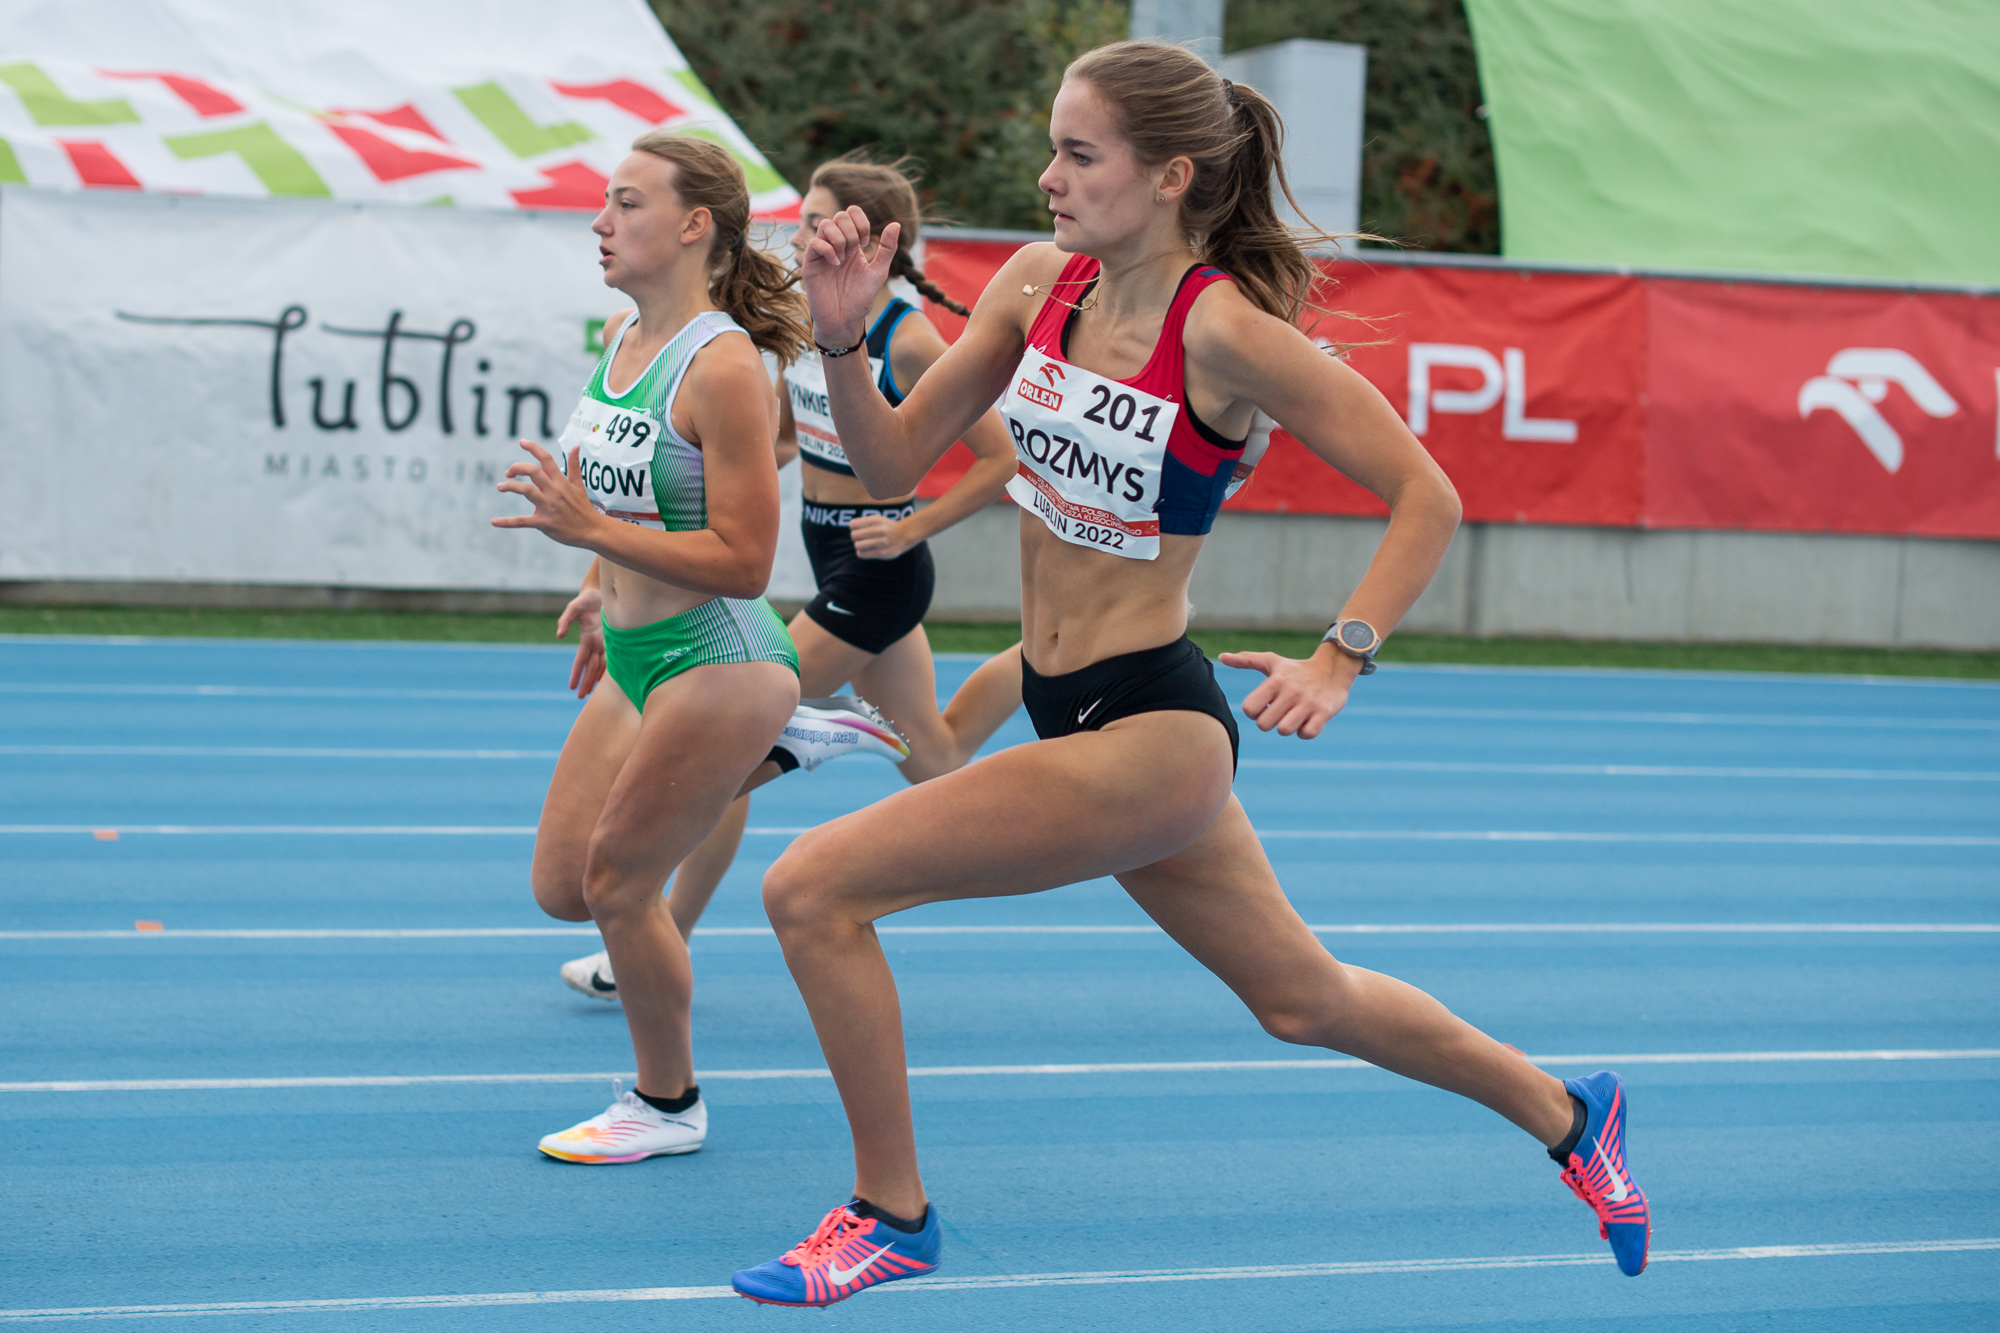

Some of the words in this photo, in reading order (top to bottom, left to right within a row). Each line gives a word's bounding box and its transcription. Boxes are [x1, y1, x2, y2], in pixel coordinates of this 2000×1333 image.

[786, 378, 833, 417] YNKIE
[1019, 380, 1061, 411] ORLEN
[1408, 342, 1578, 444] PL
[605, 413, 651, 448] 499
[1083, 384, 1162, 443] 201
[798, 433, 825, 452] UBLIN
[828, 443, 846, 459] 202
[1009, 417, 1145, 502] ROZMYS
[264, 452, 429, 483] MIASTO
[562, 451, 646, 497] AGOW
[805, 504, 856, 526] NIKE
[1033, 490, 1068, 534] LUBLIN
[1074, 522, 1125, 550] 2022
[1081, 507, 1109, 518] POLSKI
[831, 732, 859, 745] new
